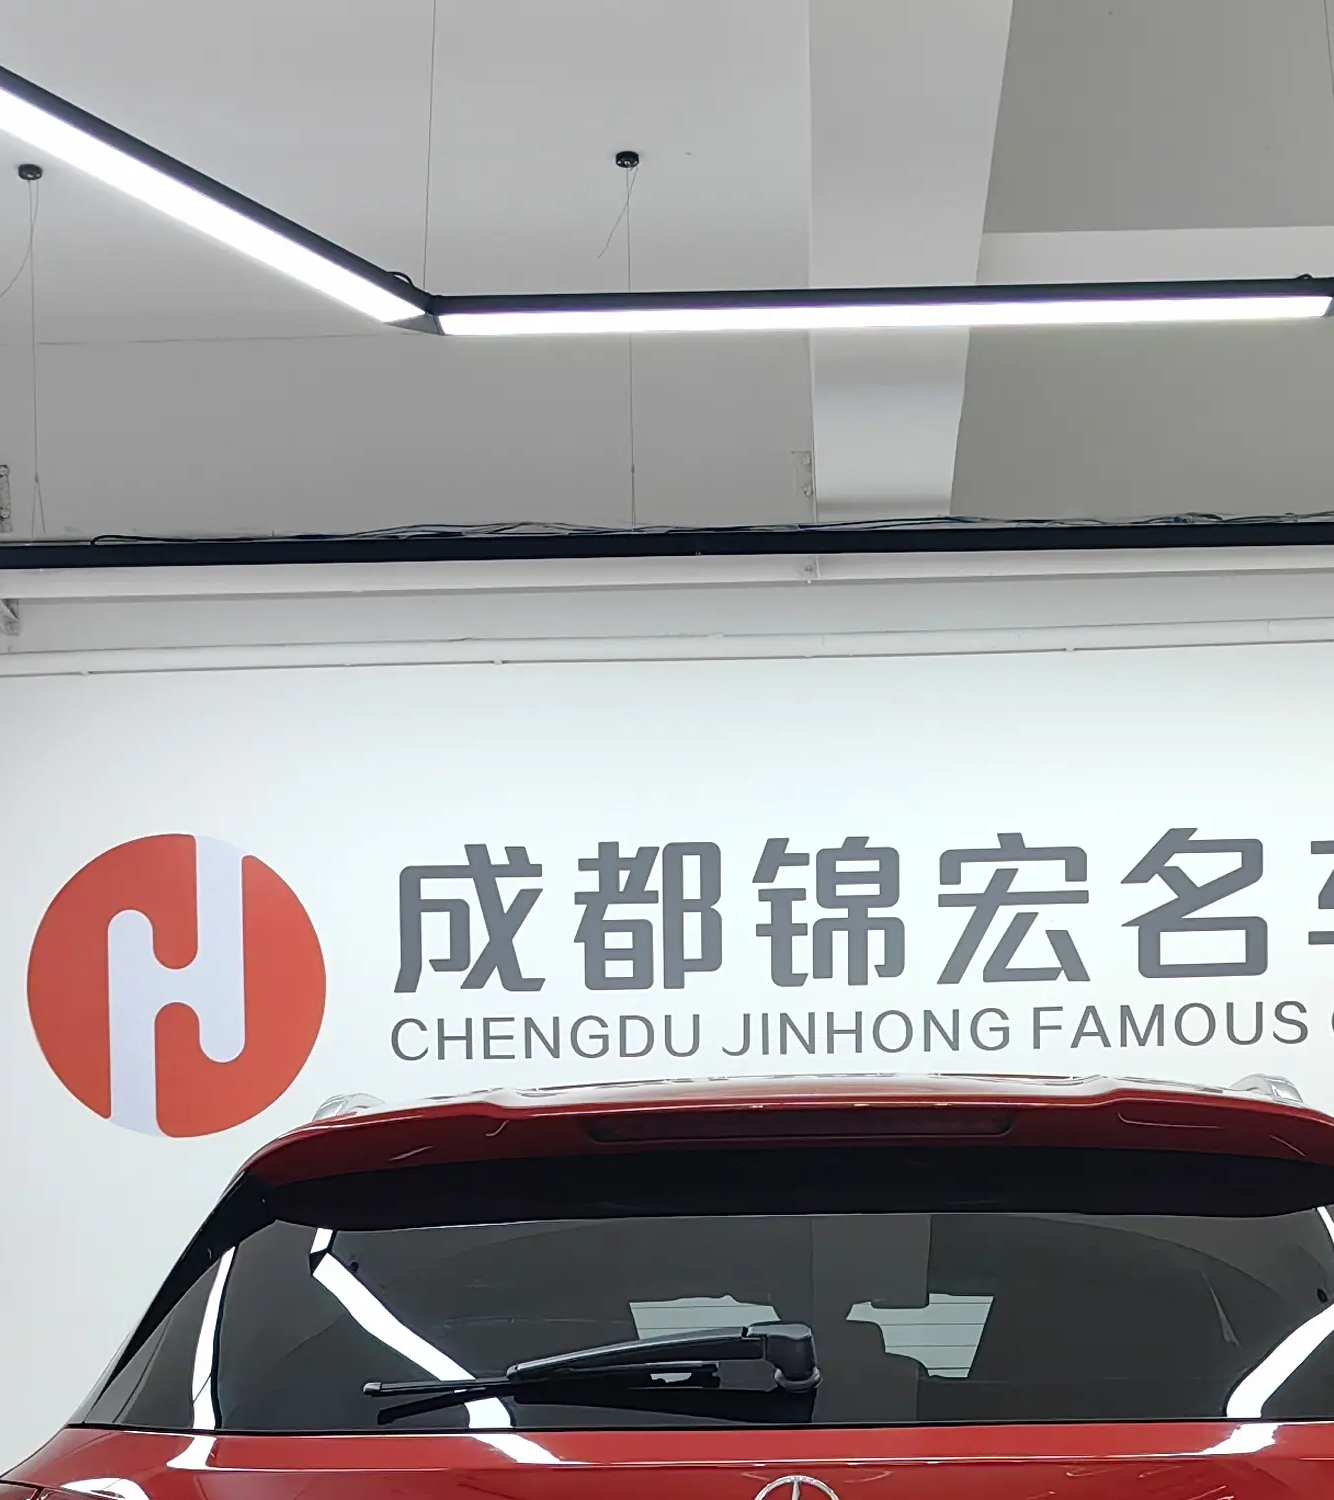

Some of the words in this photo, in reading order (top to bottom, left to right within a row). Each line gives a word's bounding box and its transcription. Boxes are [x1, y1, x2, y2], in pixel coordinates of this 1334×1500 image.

[391, 1014, 700, 1061] CHENGDU
[721, 1008, 1010, 1056] JINHONG
[1032, 1001, 1309, 1050] FAMOUS
